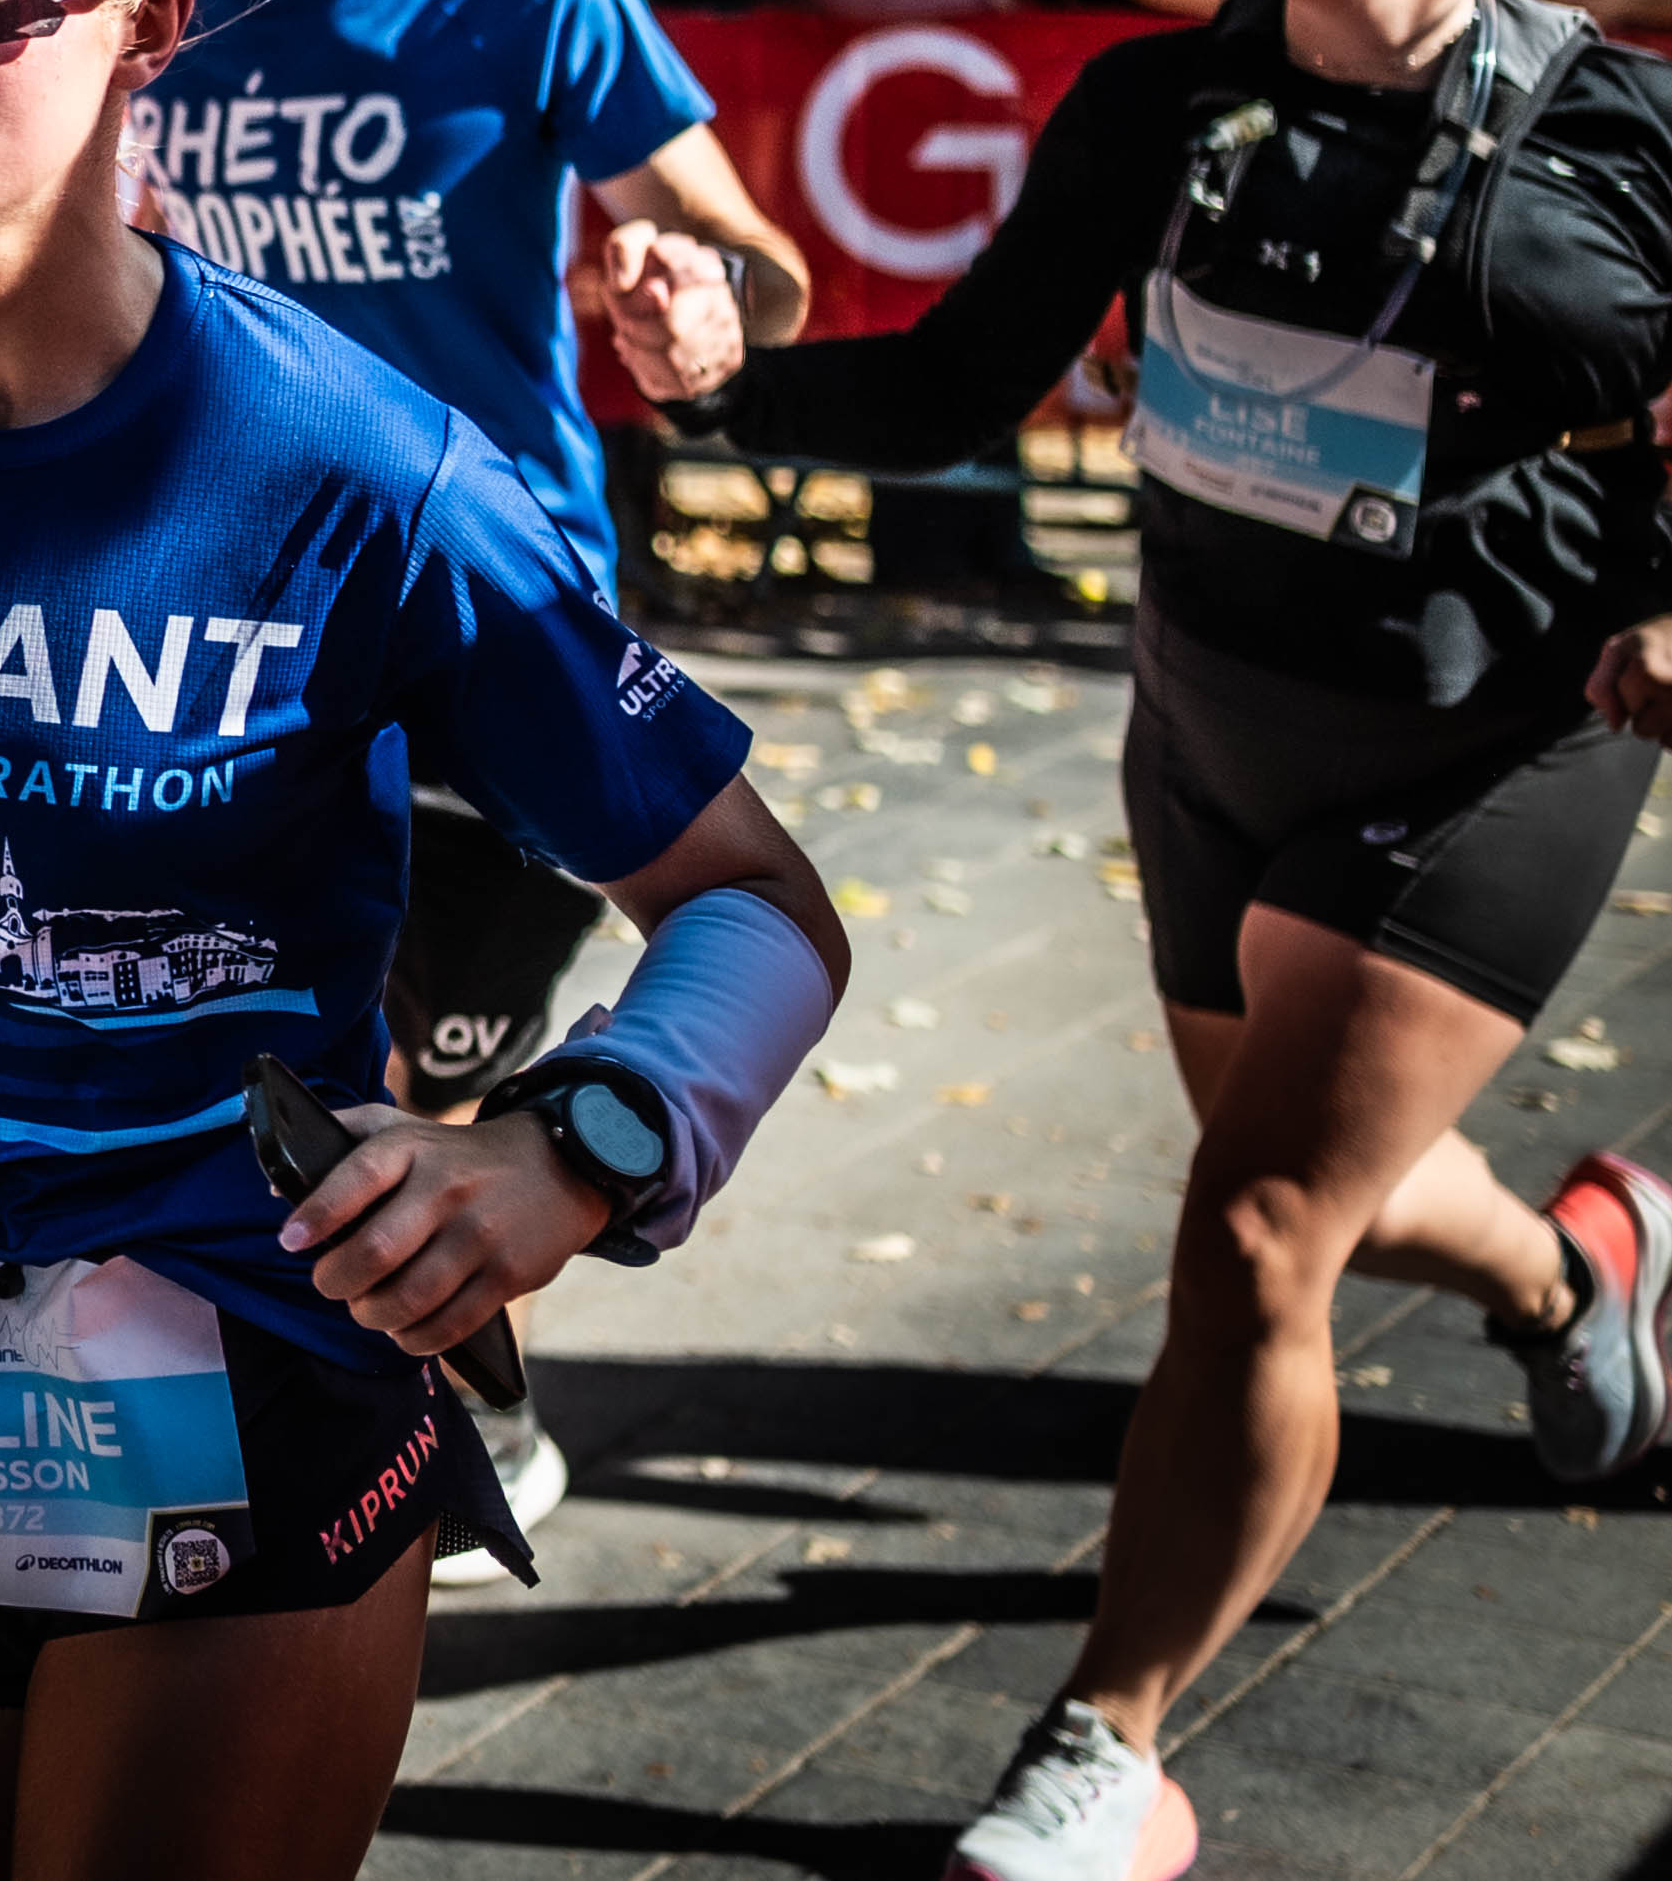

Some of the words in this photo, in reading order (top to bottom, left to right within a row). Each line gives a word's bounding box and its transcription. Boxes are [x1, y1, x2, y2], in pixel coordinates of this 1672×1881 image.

[130, 69, 407, 195] RHÉTO
[161, 179, 405, 284] ROPHÉE
[619, 657, 677, 717] ULTR
[319, 1414, 440, 1565] KIPRUN
[38, 1555, 124, 1576] DECATHLON
